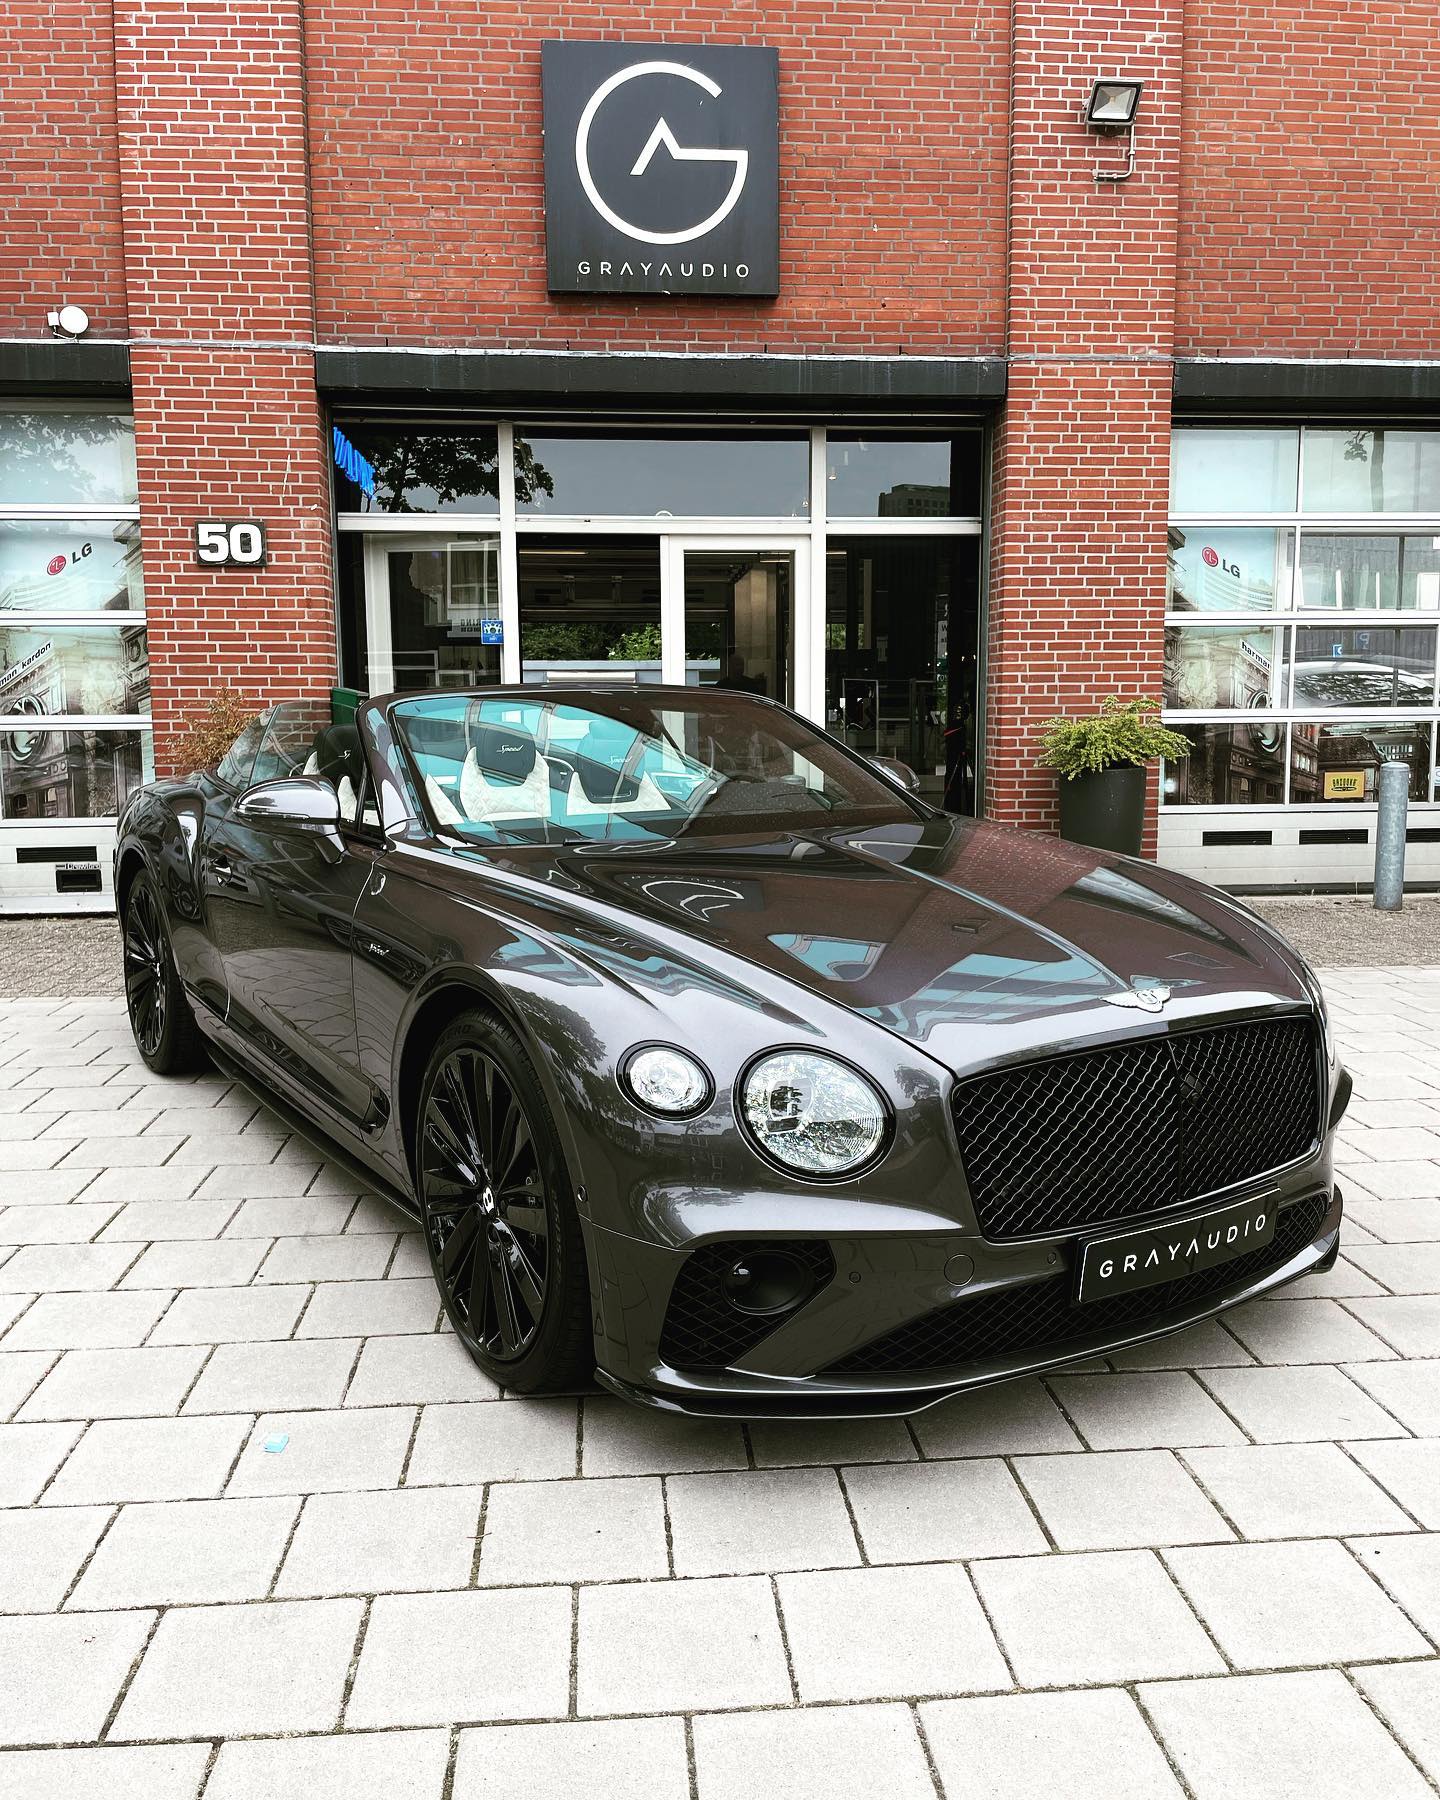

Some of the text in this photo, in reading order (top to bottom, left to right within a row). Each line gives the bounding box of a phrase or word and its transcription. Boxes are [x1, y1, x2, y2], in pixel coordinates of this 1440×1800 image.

[578, 261, 749, 278] GRAYAUDIO
[71, 542, 93, 564] LG
[198, 523, 262, 562] 50
[1222, 558, 1241, 579] LG
[21, 641, 52, 669] kardon
[1098, 1213, 1267, 1279] GRAYAUDIO
